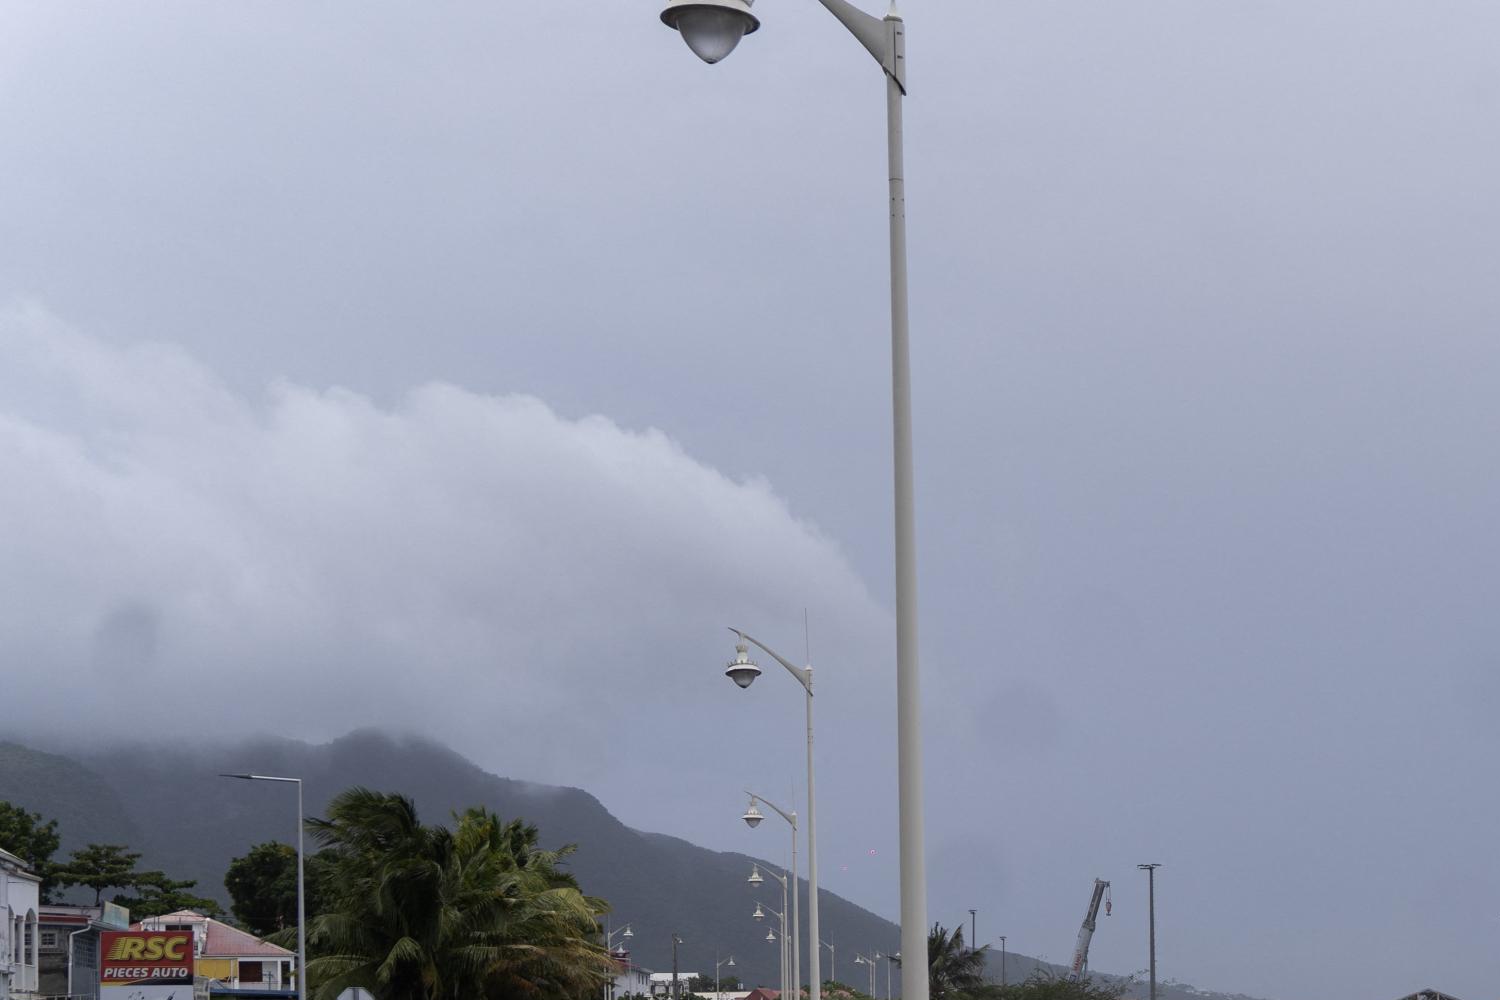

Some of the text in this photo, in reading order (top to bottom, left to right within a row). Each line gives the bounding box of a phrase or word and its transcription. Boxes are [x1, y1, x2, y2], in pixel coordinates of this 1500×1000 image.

[106, 936, 188, 961] RSC
[104, 967, 188, 978] PIECES AUTO
